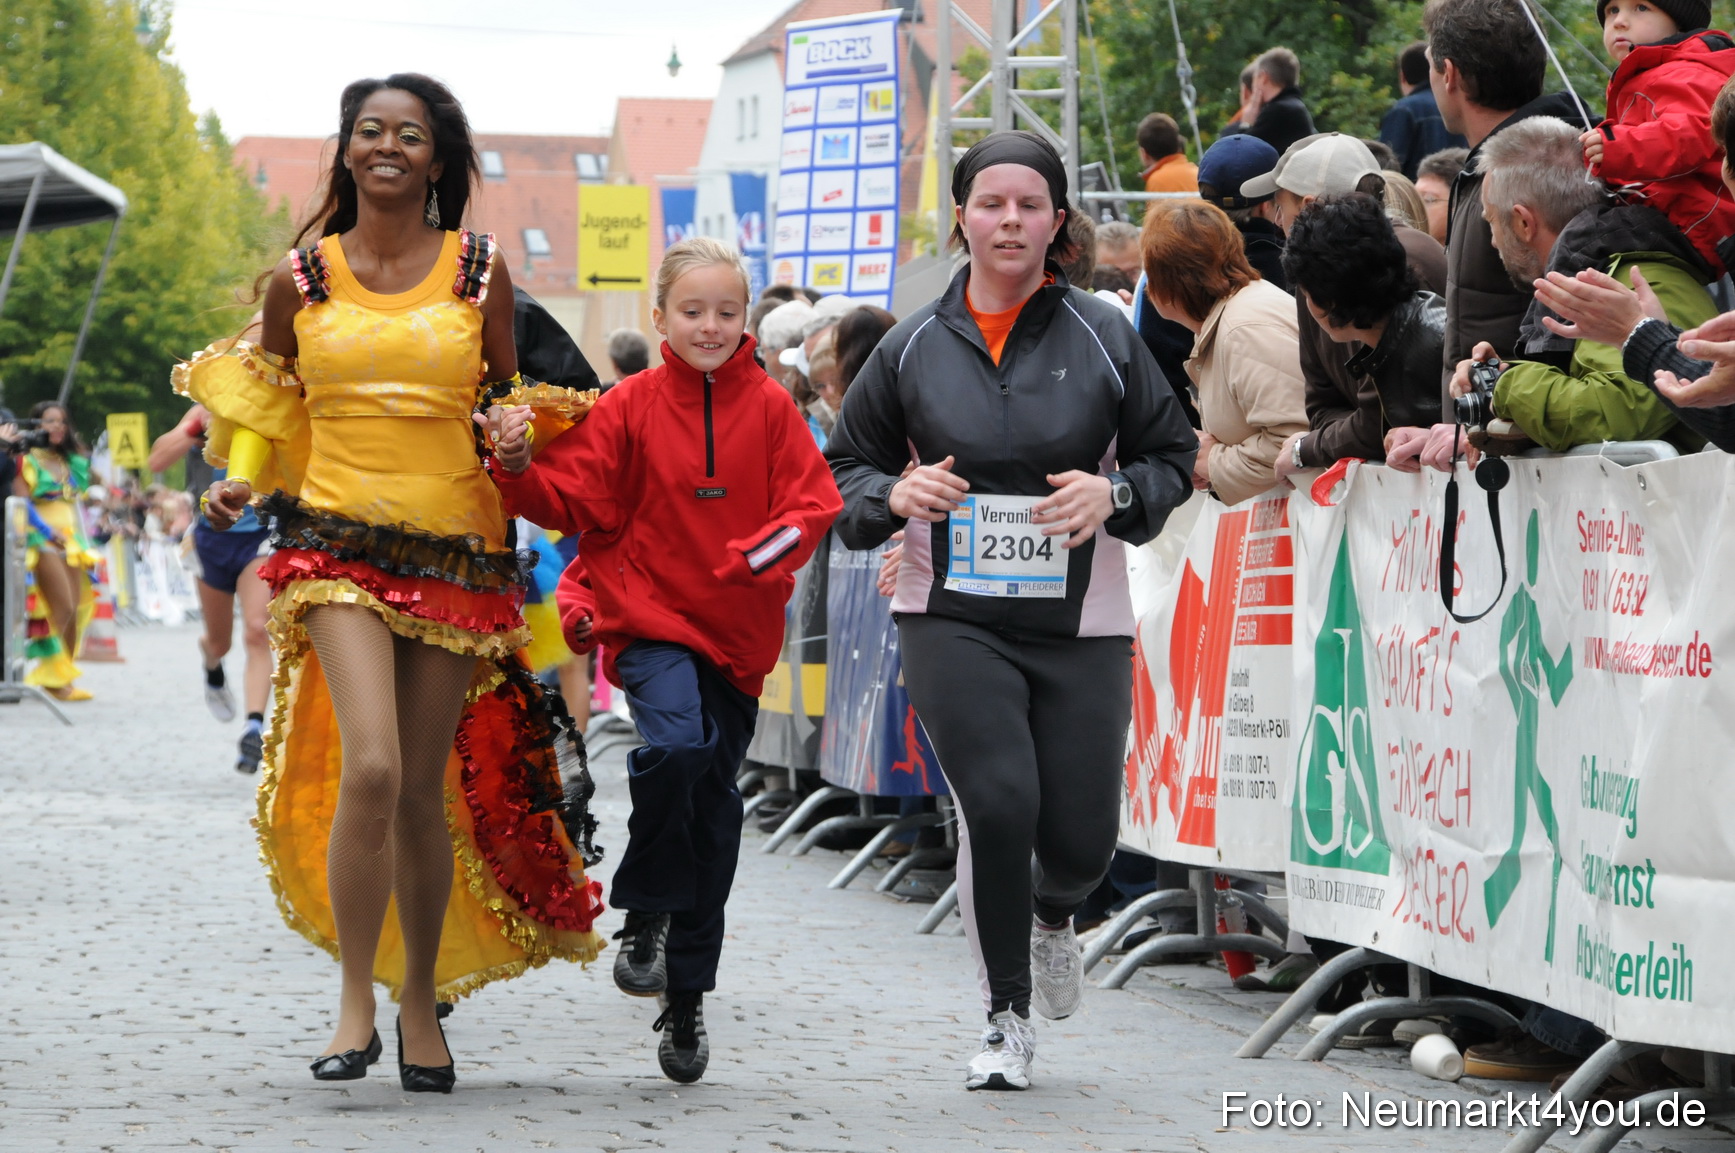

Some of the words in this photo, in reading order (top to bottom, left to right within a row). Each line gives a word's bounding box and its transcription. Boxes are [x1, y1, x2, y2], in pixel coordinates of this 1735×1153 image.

[806, 36, 872, 64] BOCK
[581, 213, 648, 232] Jugend-
[598, 232, 630, 249] lauf
[116, 430, 135, 455] A
[980, 505, 1034, 524] Veroni
[955, 531, 962, 545] D
[981, 534, 1053, 562] 2304
[1020, 582, 1064, 592] PFLEIDERER
